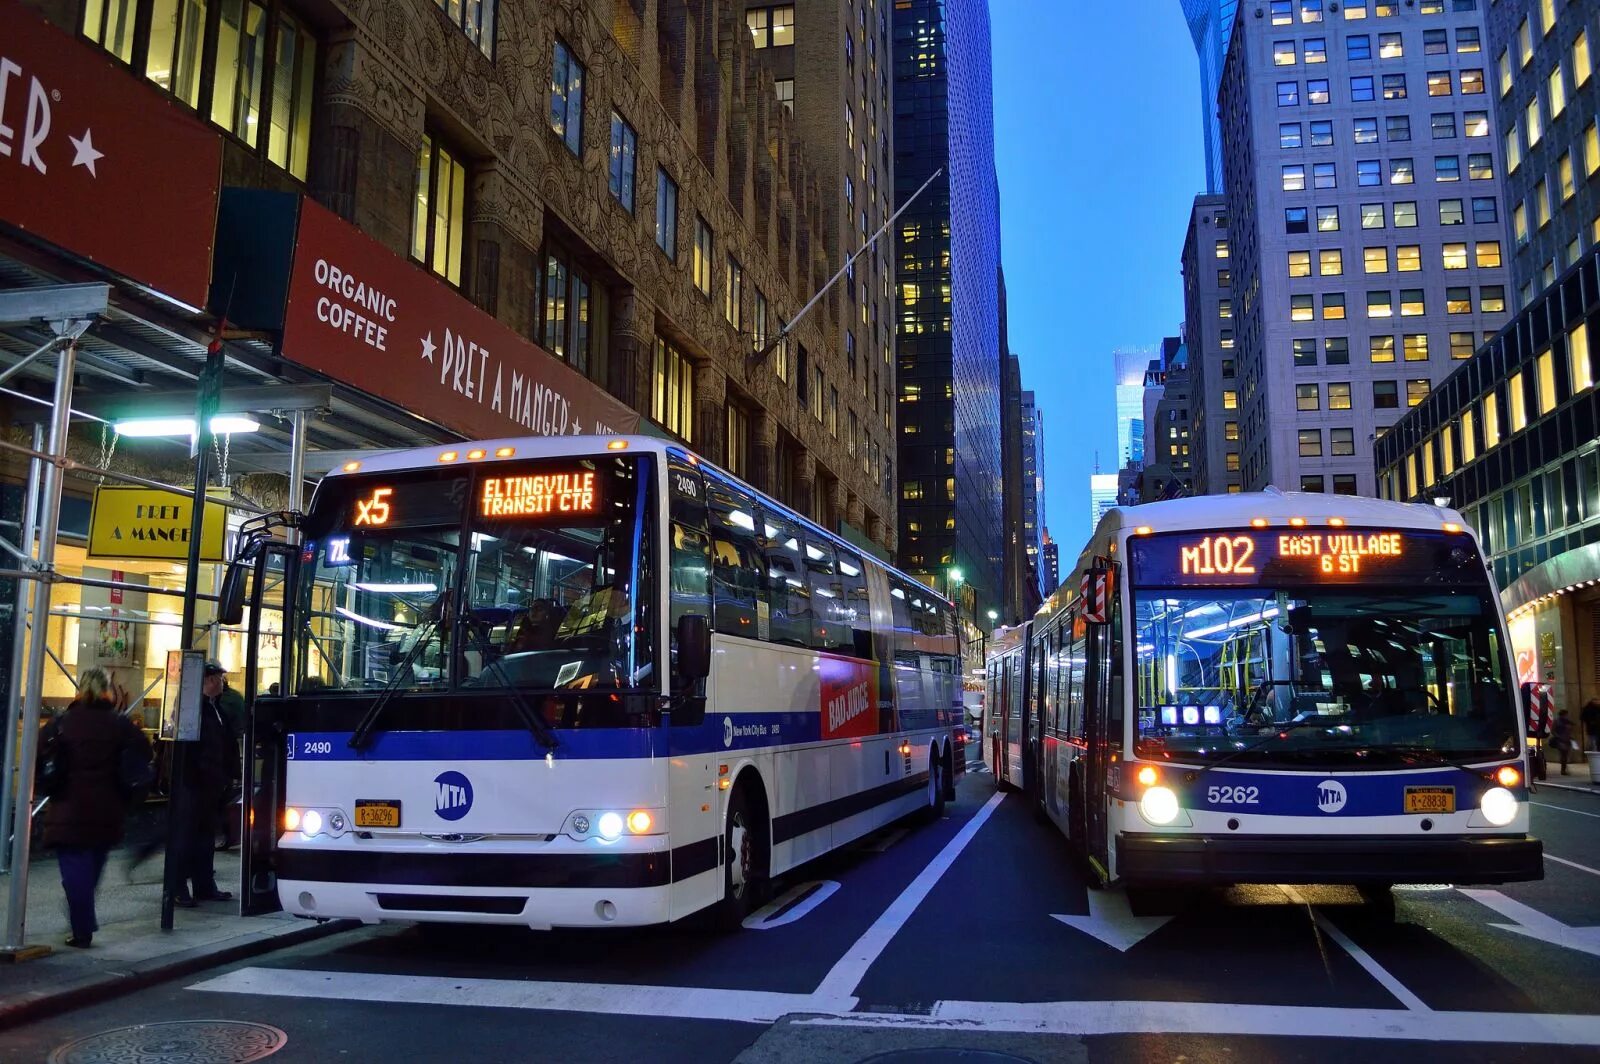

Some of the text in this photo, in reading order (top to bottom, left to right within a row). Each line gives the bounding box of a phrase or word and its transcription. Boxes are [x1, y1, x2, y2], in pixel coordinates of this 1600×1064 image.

[314, 258, 397, 322] ORGANIC
[316, 296, 388, 352] COFFEE
[440, 327, 489, 403] PRET
[491, 360, 502, 414] A
[484, 472, 594, 498] ELTINGVILLE
[676, 474, 697, 498] 2490
[136, 504, 182, 520] PRET
[483, 492, 593, 516] TRANSIT CTR
[110, 525, 194, 542] A MANGE
[1278, 534, 1402, 555] EAST VILLAGE
[1181, 536, 1256, 575] M102
[1321, 554, 1361, 573] 6 ST
[828, 681, 870, 733] BAD JUDGE
[733, 726, 743, 737] New
[743, 725, 751, 736] York
[751, 724, 760, 737] City
[304, 741, 332, 754] 2490
[433, 781, 468, 811] MTA
[1207, 785, 1260, 804] 5262
[1317, 786, 1343, 806] MTA
